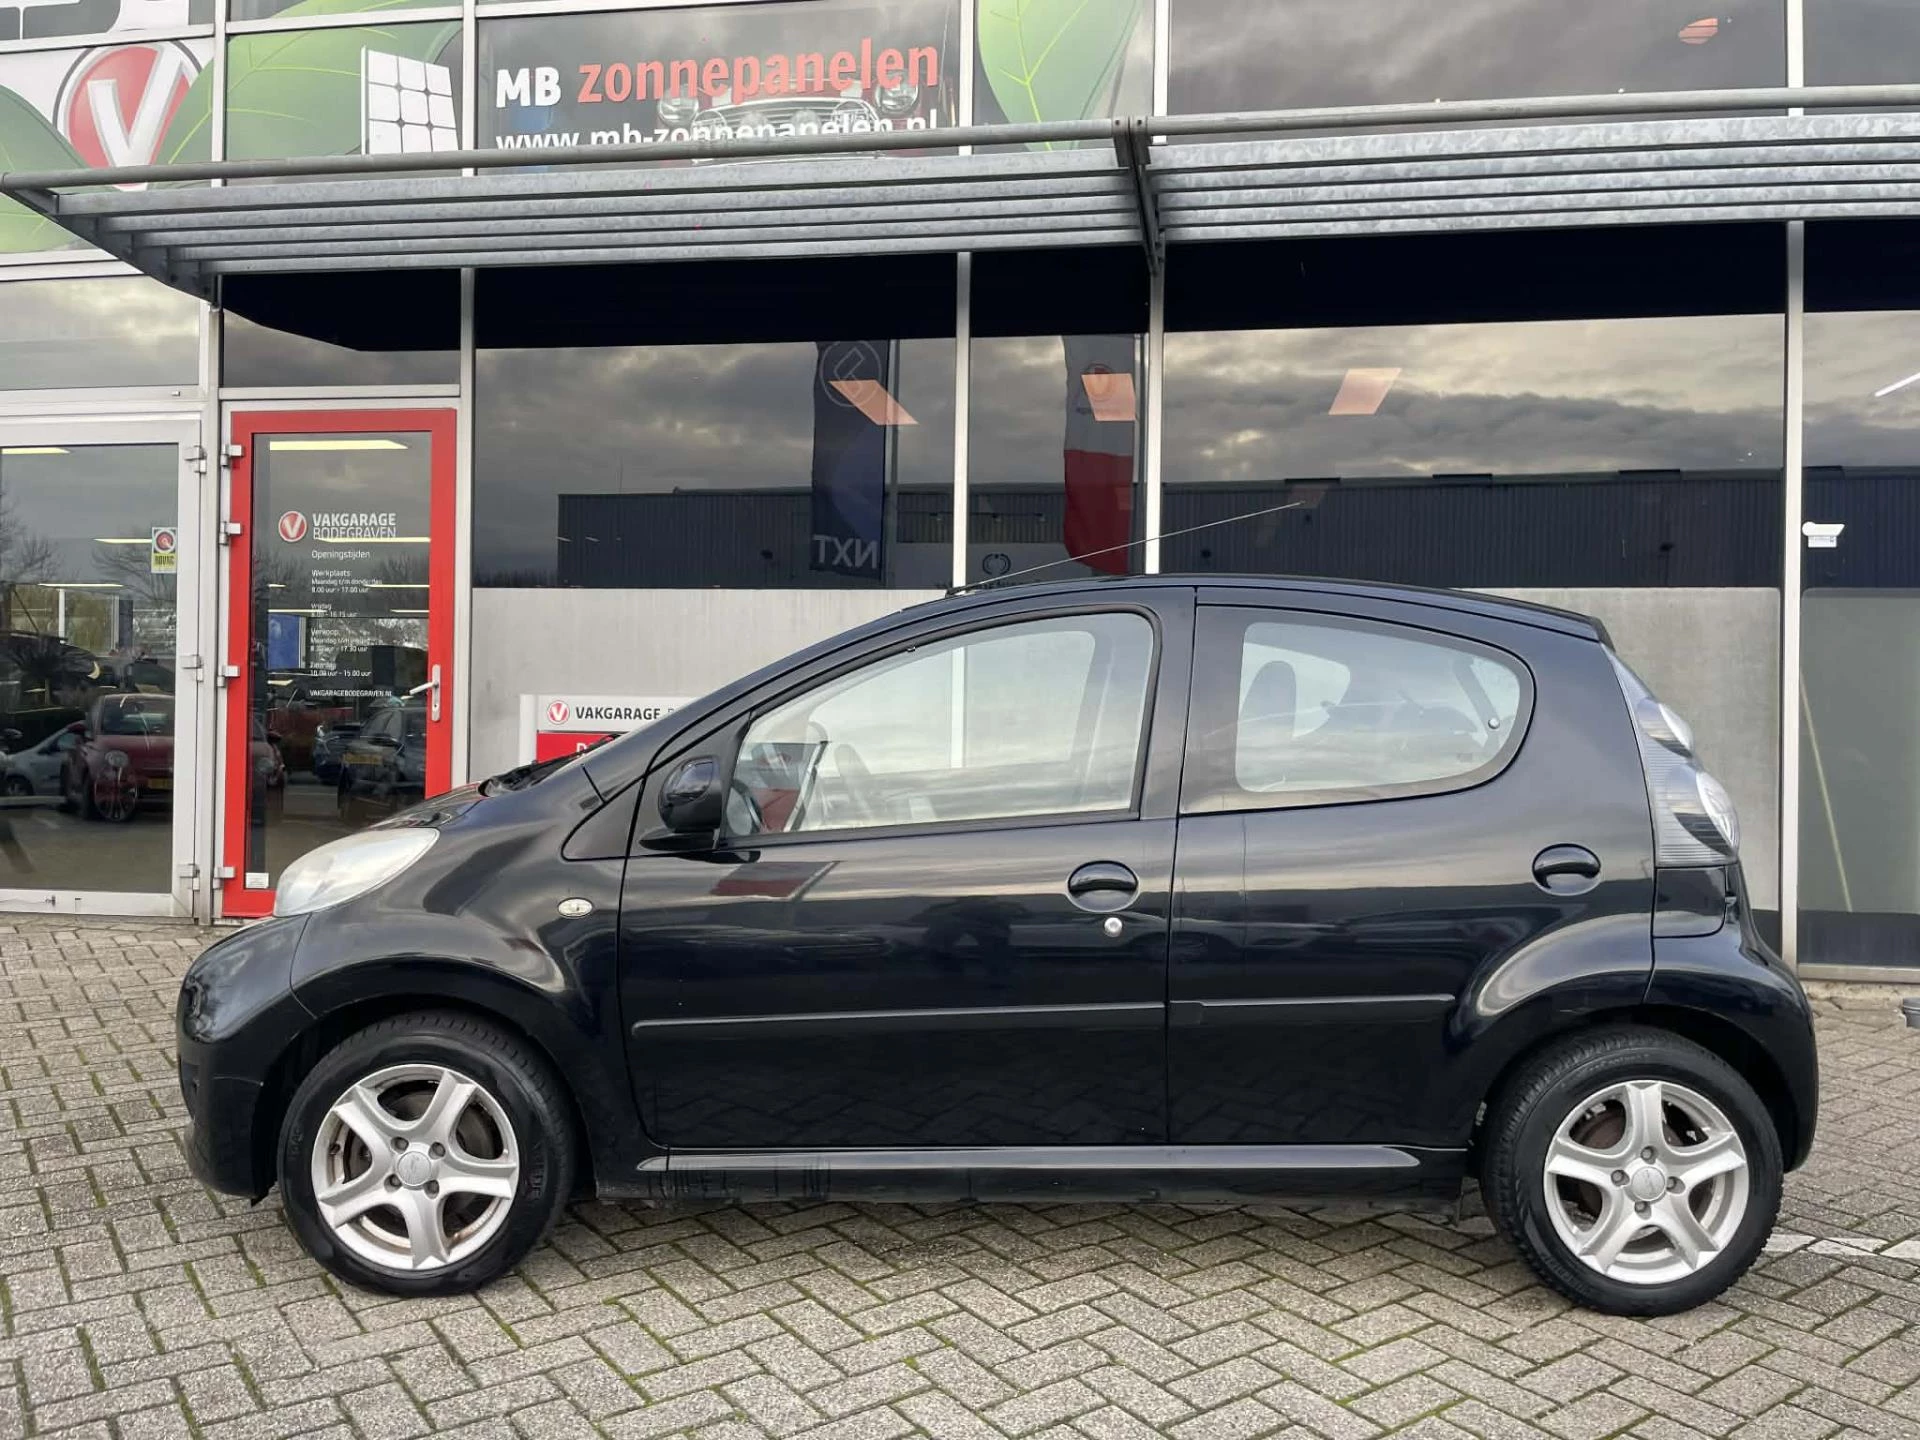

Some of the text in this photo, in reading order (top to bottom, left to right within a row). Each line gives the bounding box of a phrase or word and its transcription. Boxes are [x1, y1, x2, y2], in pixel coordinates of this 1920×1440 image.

[495, 37, 939, 108] MB zonnepanelen
[495, 108, 937, 149] wwwmb-zonnepanelennl
[312, 513, 397, 526] VAKGARAGE
[313, 527, 396, 540] BODEGRAVEN
[311, 549, 371, 560] Openingstijden
[575, 706, 660, 720] VAKGARAGE
